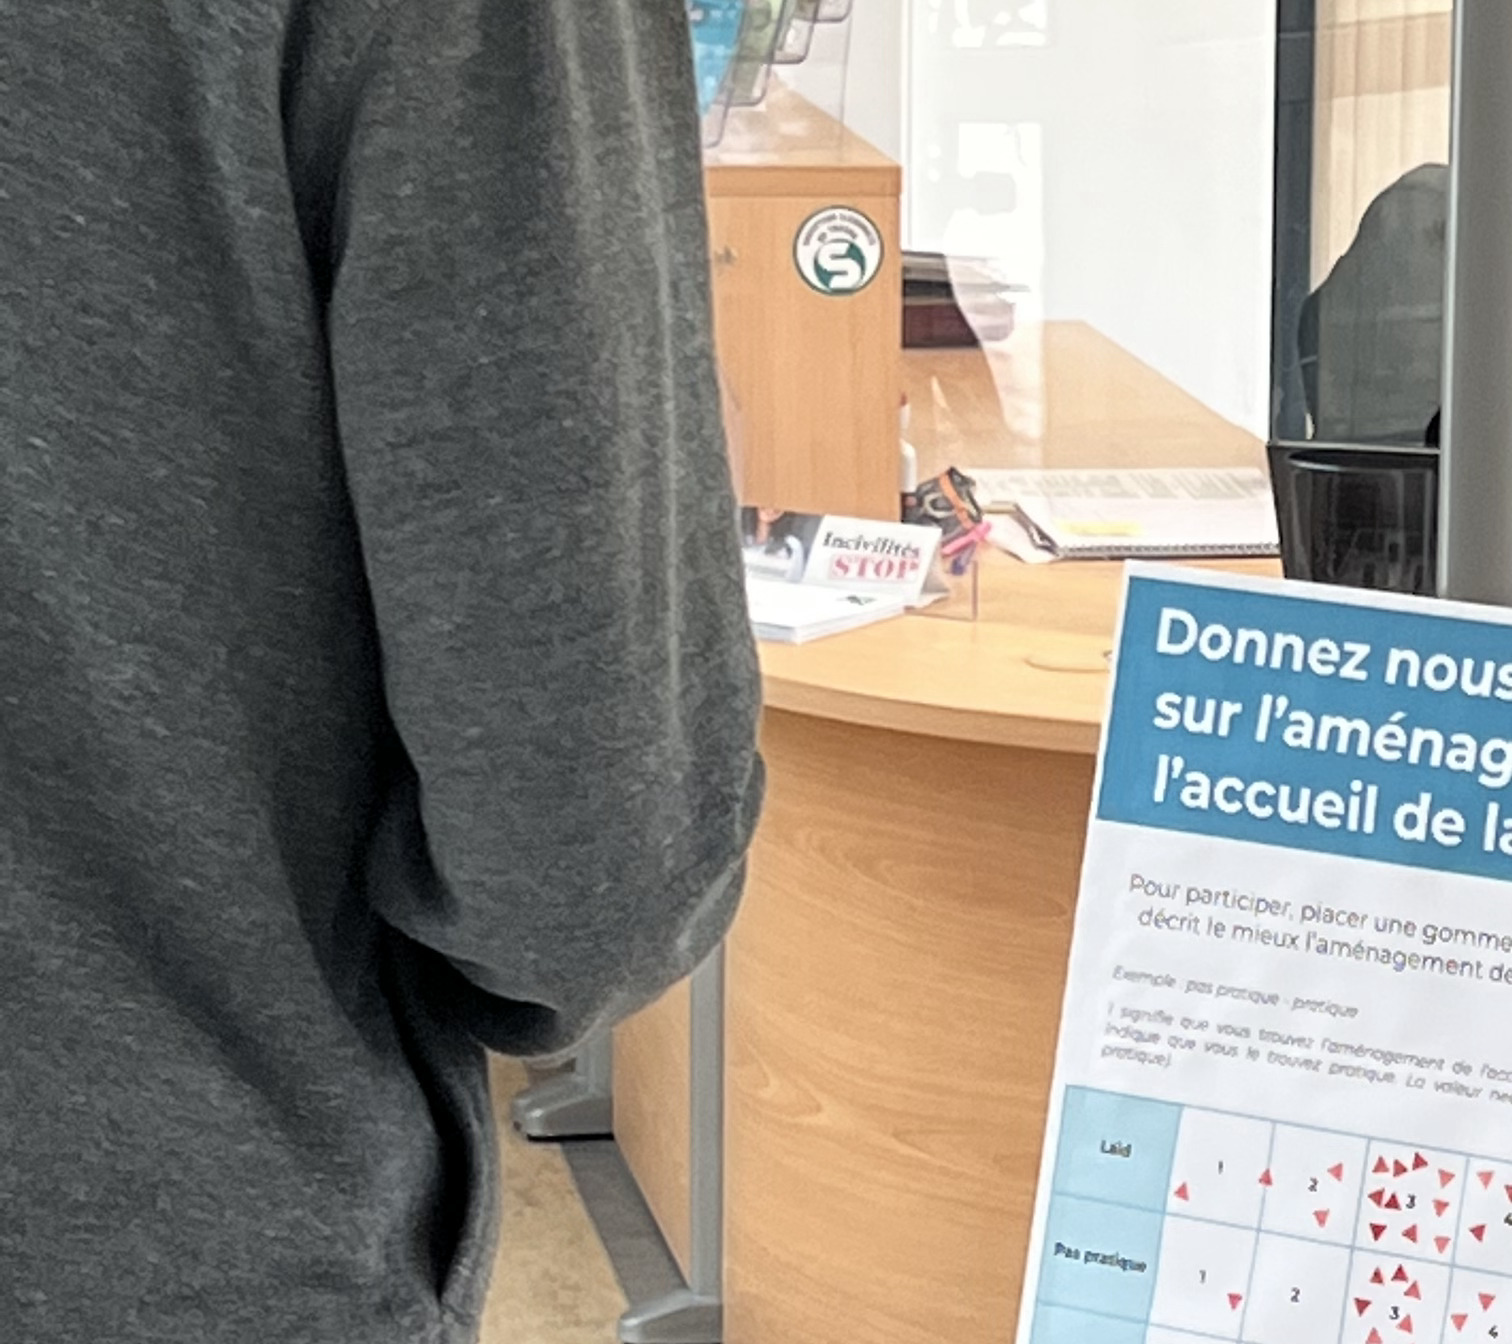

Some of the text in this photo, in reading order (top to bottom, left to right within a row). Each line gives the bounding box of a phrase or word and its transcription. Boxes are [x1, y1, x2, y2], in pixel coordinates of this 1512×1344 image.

[823, 531, 920, 558] Incivilités
[834, 556, 920, 579] STOP
[1156, 607, 1370, 681] Donnez
[1153, 692, 1242, 737] sur
[1154, 754, 1378, 835] l'accueil
[1393, 792, 1466, 846] de
[1129, 873, 1180, 901] Pour
[1186, 885, 1294, 921] participer,
[1300, 904, 1367, 930] placer
[1374, 914, 1417, 937] une
[1138, 907, 1200, 934] décrit
[1207, 916, 1226, 939] le
[1232, 924, 1299, 951] mieux
[1305, 930, 1483, 980] l'aménagement
[1112, 965, 1359, 1018] Exemple pas pratique pratique
[1120, 1007, 1174, 1026] signifie
[1180, 1017, 1209, 1031] que
[1217, 1024, 1250, 1038] vous
[1258, 1028, 1315, 1049] trouvez
[1321, 1037, 1446, 1071] l'aménagement
[1452, 1060, 1473, 1076] de
[1105, 1022, 1161, 1044] indique
[1167, 1035, 1196, 1050] que
[1204, 1041, 1239, 1058] vous
[1246, 1046, 1261, 1061] le
[1267, 1050, 1324, 1073] trouvez
[1405, 1074, 1426, 1089] La
[1434, 1080, 1483, 1099] valeur
[1100, 1139, 1133, 1158] Laid
[1217, 1160, 1224, 1175] 1
[1308, 1177, 1319, 1193] 2
[1406, 1193, 1417, 1209] 3
[1054, 1241, 1148, 1274] Pas pratique
[1198, 1269, 1207, 1284] 1
[1290, 1287, 1301, 1303] 2
[1389, 1305, 1401, 1321] 3
[1487, 1324, 1500, 1339] 4
